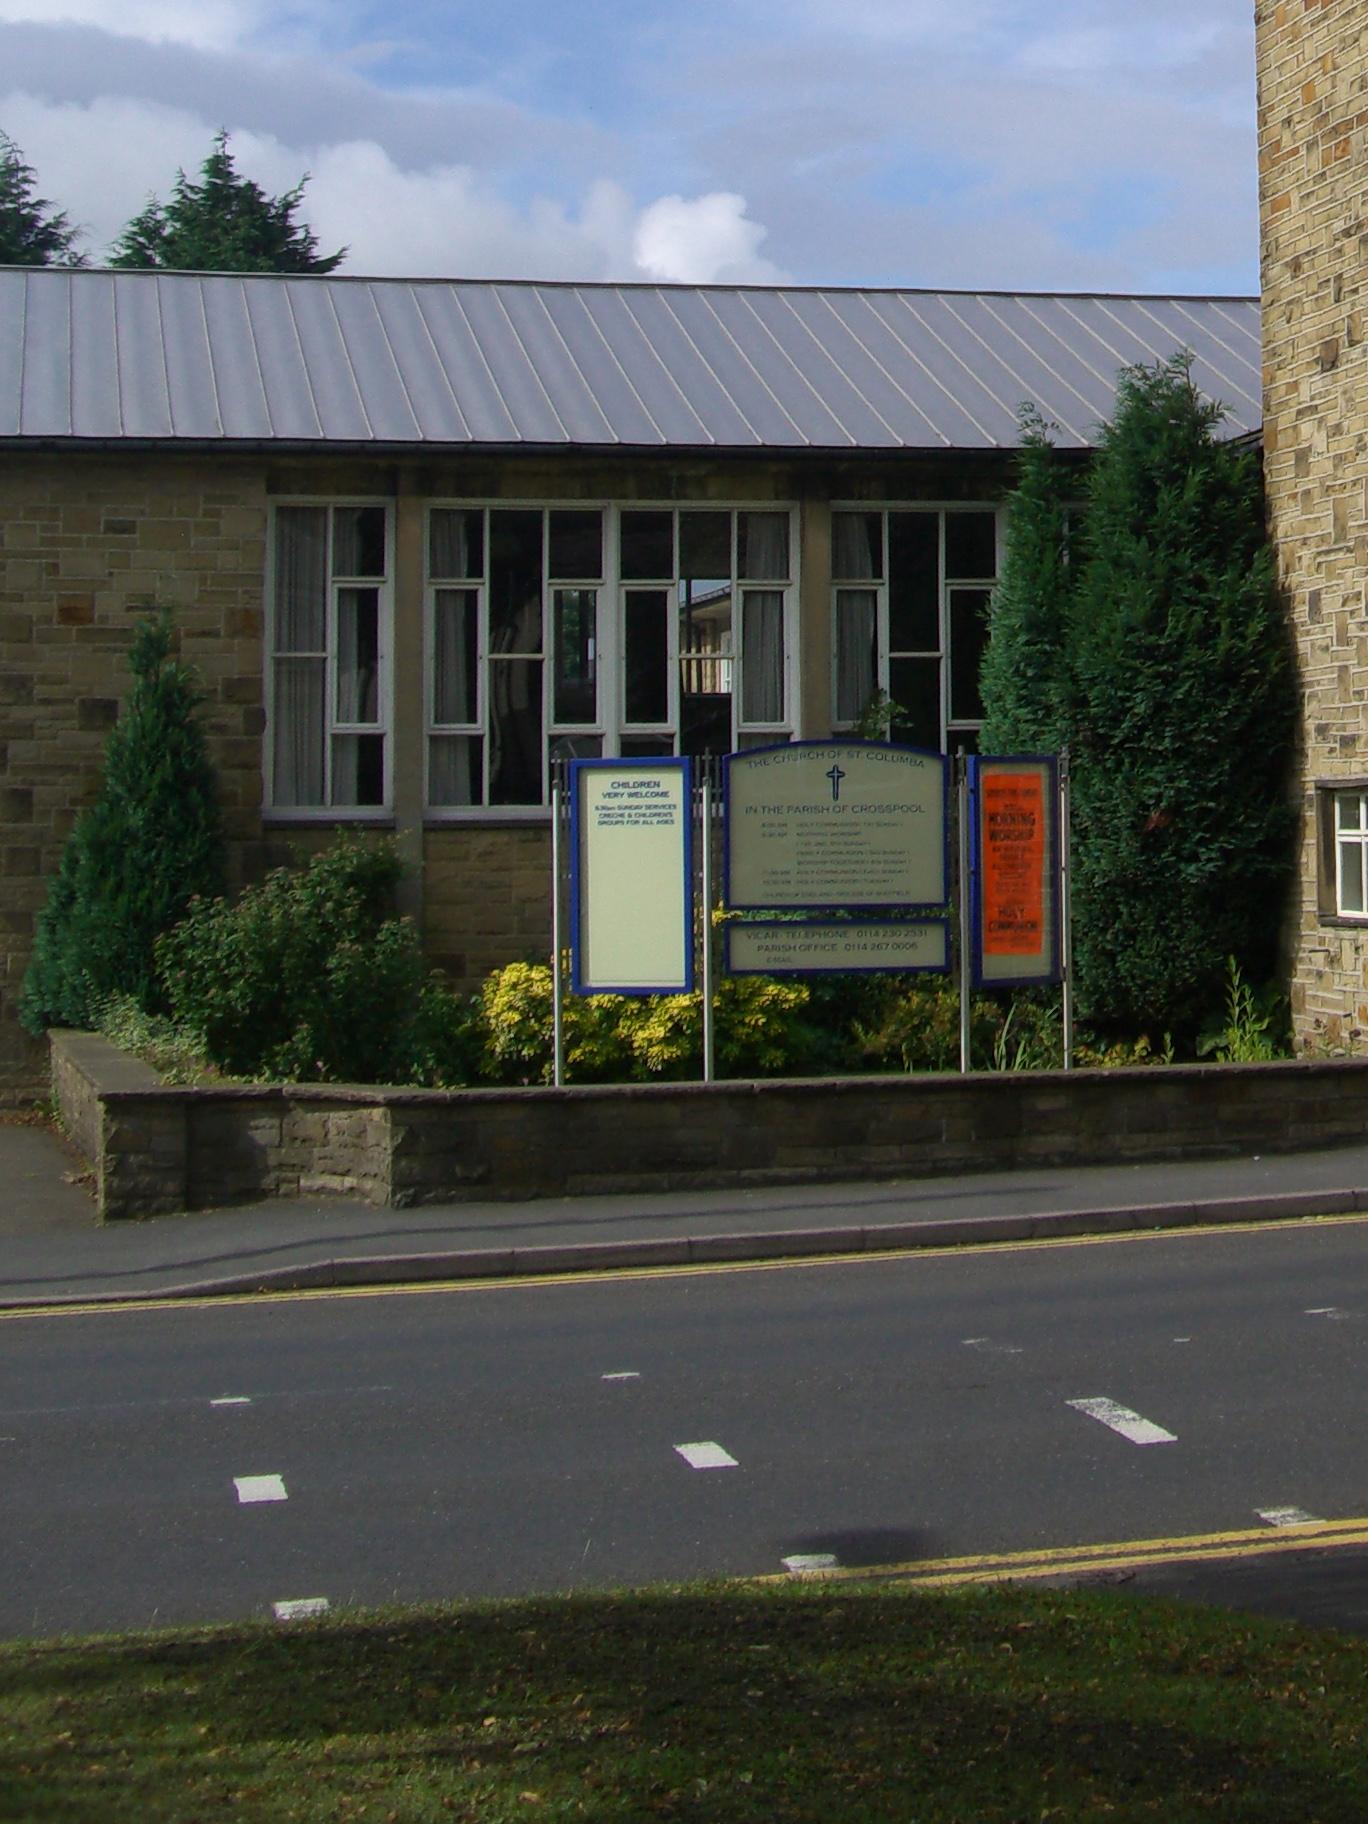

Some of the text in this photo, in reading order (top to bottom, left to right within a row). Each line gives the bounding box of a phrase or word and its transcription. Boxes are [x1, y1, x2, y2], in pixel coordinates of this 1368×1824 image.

[748, 750, 925, 768] THE CHURCH OF ST COLUMBA
[610, 780, 661, 789] CHILDREN
[602, 790, 670, 799] VERY WELCOME
[745, 803, 926, 815] IN THE PARISH OF CROSSPOOL
[989, 812, 1035, 826] MORNING
[989, 828, 1034, 842] WORSHIP
[988, 920, 1037, 933] COMMUNION
[746, 930, 778, 940] VICAR
[786, 929, 848, 939] TELEPHONE
[856, 929, 880, 938] 0114
[757, 943, 797, 952] PARISH
[798, 943, 838, 951] OFFICE
[844, 942, 868, 951] 0114
[870, 942, 890, 951] 267
